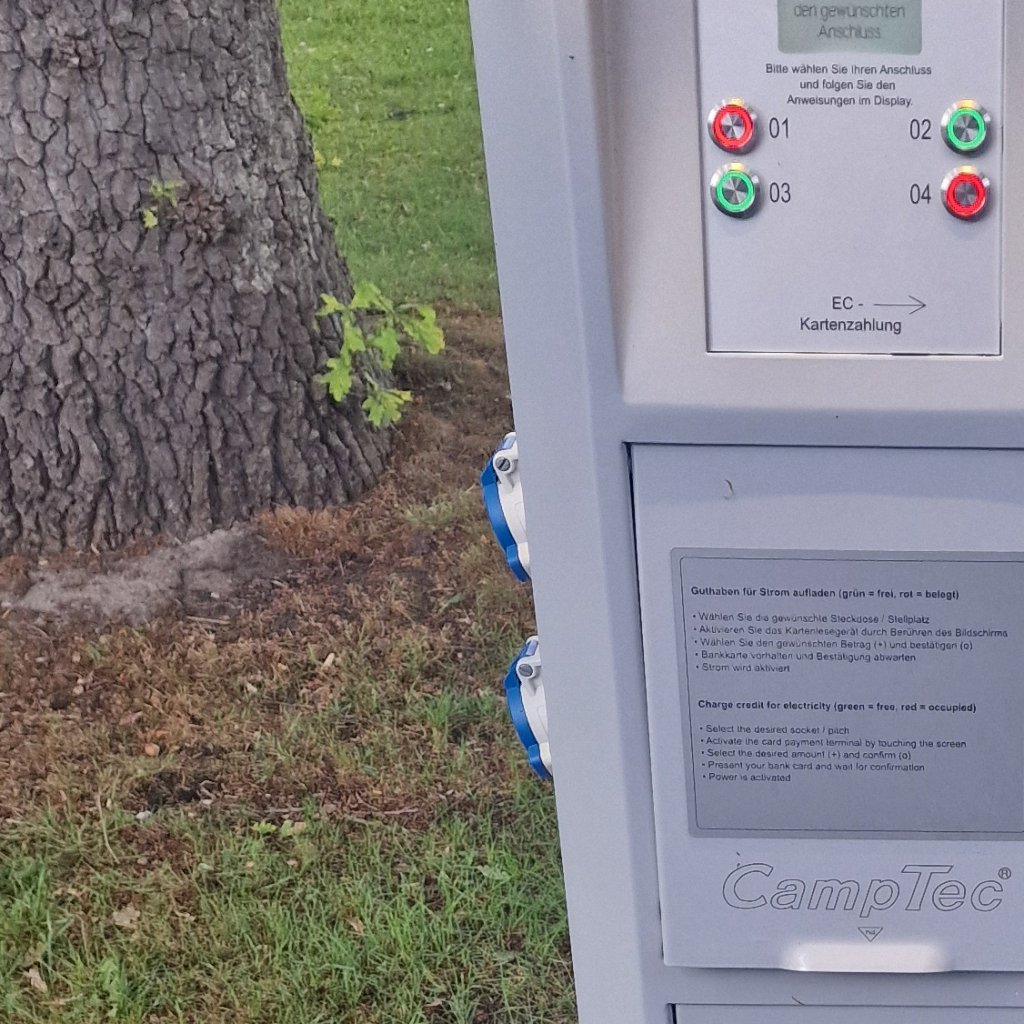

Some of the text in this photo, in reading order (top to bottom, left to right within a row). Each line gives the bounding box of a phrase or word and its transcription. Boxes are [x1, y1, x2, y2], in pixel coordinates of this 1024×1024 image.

[794, 4, 817, 17] den
[818, 24, 881, 39] Anschluss
[765, 63, 932, 75] Bitte wählen Sie Ihren Anschluss
[800, 79, 896, 92] und folgen Sie den
[786, 95, 913, 108] Anweisungen im Display.
[769, 117, 789, 139] 01
[909, 119, 931, 140] 02
[769, 182, 791, 203] 03
[909, 184, 931, 204] 04
[800, 317, 902, 335] Kartenzahlung
[691, 586, 740, 597] Guthaben
[743, 587, 756, 596] für
[759, 588, 790, 597] Strom
[793, 588, 835, 597] aufladen
[839, 588, 865, 600] (grün
[877, 589, 896, 599] frei,
[899, 590, 913, 598] rot
[925, 590, 959, 601] belegt)
[698, 612, 734, 621] Wählen
[737, 613, 752, 622] Sie
[755, 613, 769, 622] die
[830, 614, 879, 623] Steckdose
[887, 615, 930, 625] Stellplatz
[699, 625, 745, 634] Aktivieren
[748, 625, 763, 635] Sie
[765, 626, 782, 635] das
[861, 628, 887, 637] durch
[890, 628, 933, 637] Berühren
[935, 628, 952, 637] des
[955, 628, 1008, 638] Bildschirms
[700, 638, 736, 647] Wählen
[738, 638, 753, 647] Sie
[756, 639, 774, 647] den
[840, 639, 871, 650] Betrag
[889, 641, 907, 649] und
[909, 641, 957, 651] bestätigen
[701, 650, 916, 663] Bankkarte vorhalten und Bestätigung abwarten
[701, 663, 790, 672] Strom wird aktiviert
[698, 700, 733, 710] Charge
[736, 701, 764, 709] credit
[767, 701, 780, 709] for
[783, 702, 831, 712] electricity
[834, 702, 865, 712] (green
[877, 703, 898, 712] free,
[901, 703, 917, 711] red
[928, 703, 976, 713] occupied)
[706, 724, 734, 733] Select
[737, 725, 751, 733] the
[790, 726, 820, 734] socket
[828, 727, 849, 735] pitch
[706, 737, 742, 745] Activate
[745, 737, 759, 745] the
[762, 738, 782, 746] card
[784, 739, 824, 748] payment
[826, 739, 862, 747] terminal
[865, 740, 875, 749] by
[878, 740, 917, 749] touching
[919, 740, 934, 748] the
[706, 749, 735, 757] Select
[738, 749, 753, 758] the
[755, 750, 788, 758] desired
[827, 750, 841, 759] (+)
[843, 751, 860, 759] and
[862, 751, 896, 759] confirm
[707, 761, 743, 769] Present
[745, 762, 765, 771] your
[792, 762, 813, 770] card
[815, 762, 832, 770] and
[835, 763, 853, 771] wait
[855, 763, 867, 771] for
[870, 763, 925, 771] confirmation
[750, 774, 791, 782] activated
